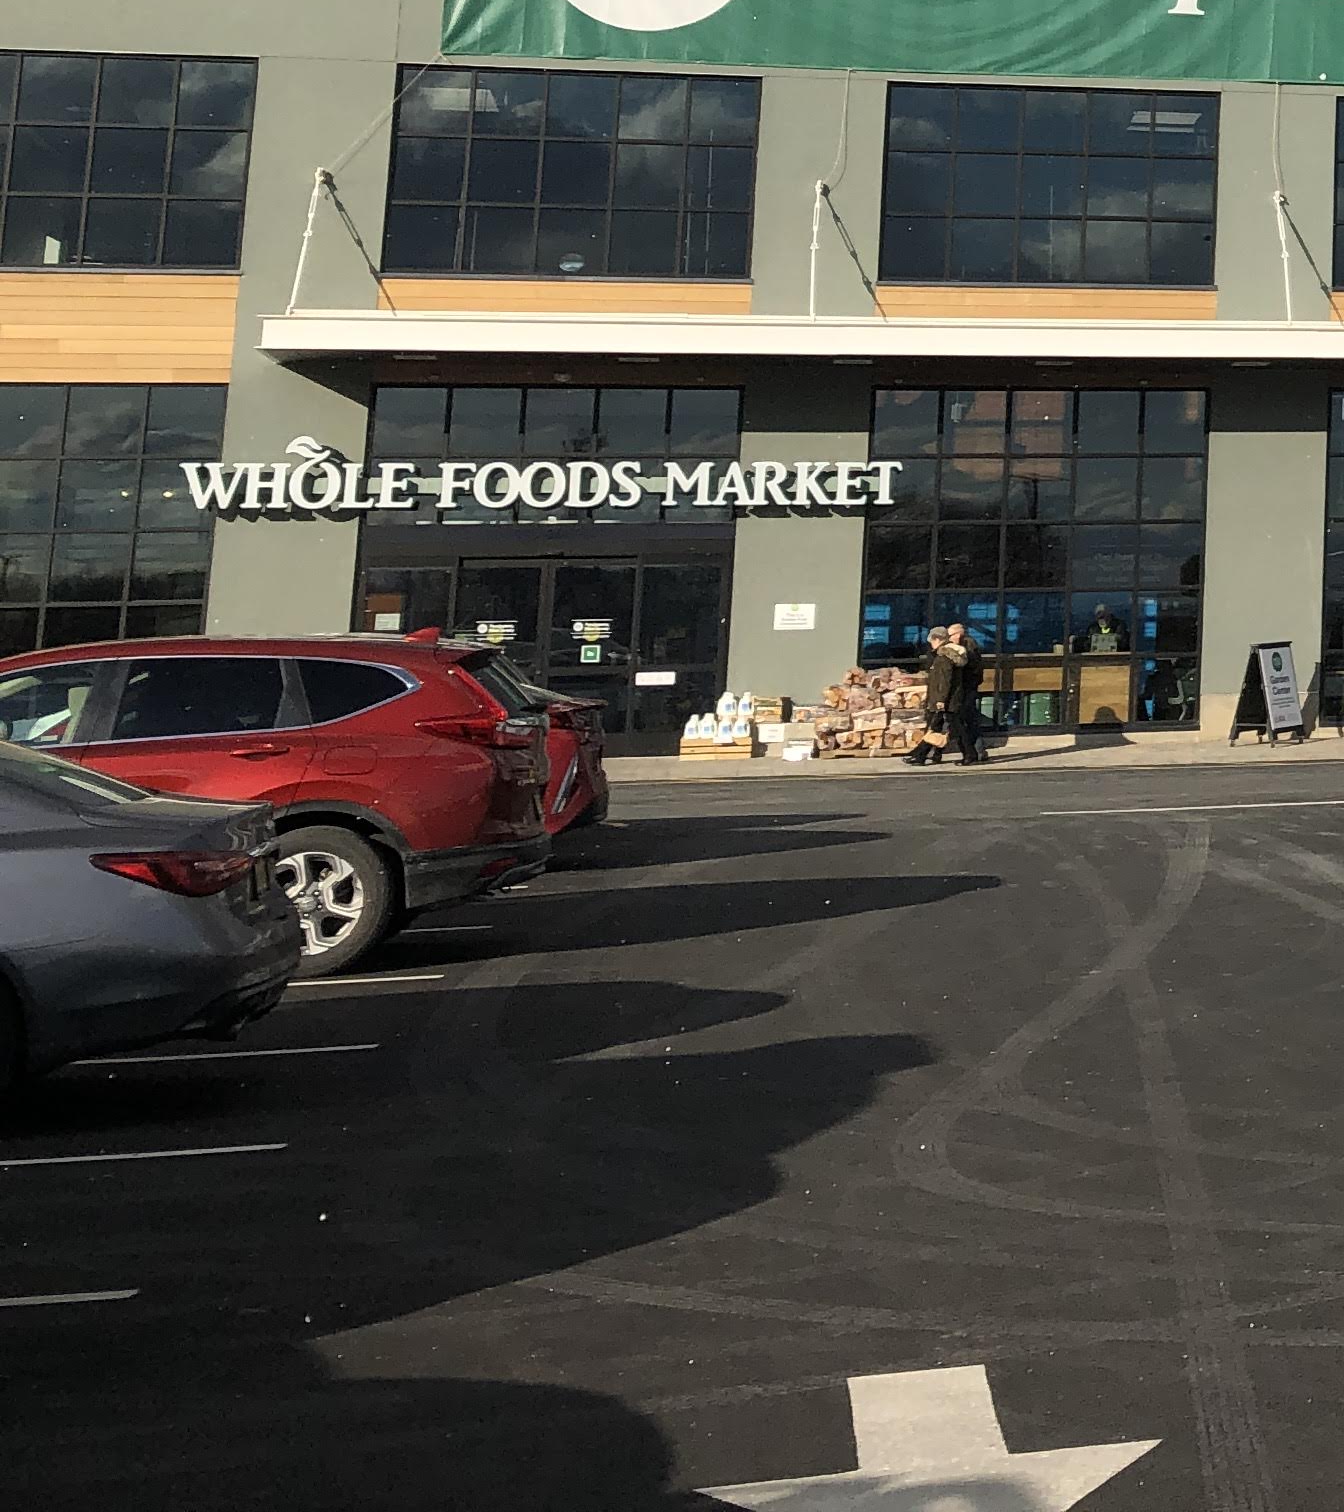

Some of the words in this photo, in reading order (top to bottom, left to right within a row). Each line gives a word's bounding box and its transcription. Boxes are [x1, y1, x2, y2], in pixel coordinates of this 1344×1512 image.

[179, 451, 415, 509] WHOLE
[435, 460, 642, 508] FOODS
[661, 460, 903, 506] MARKET
